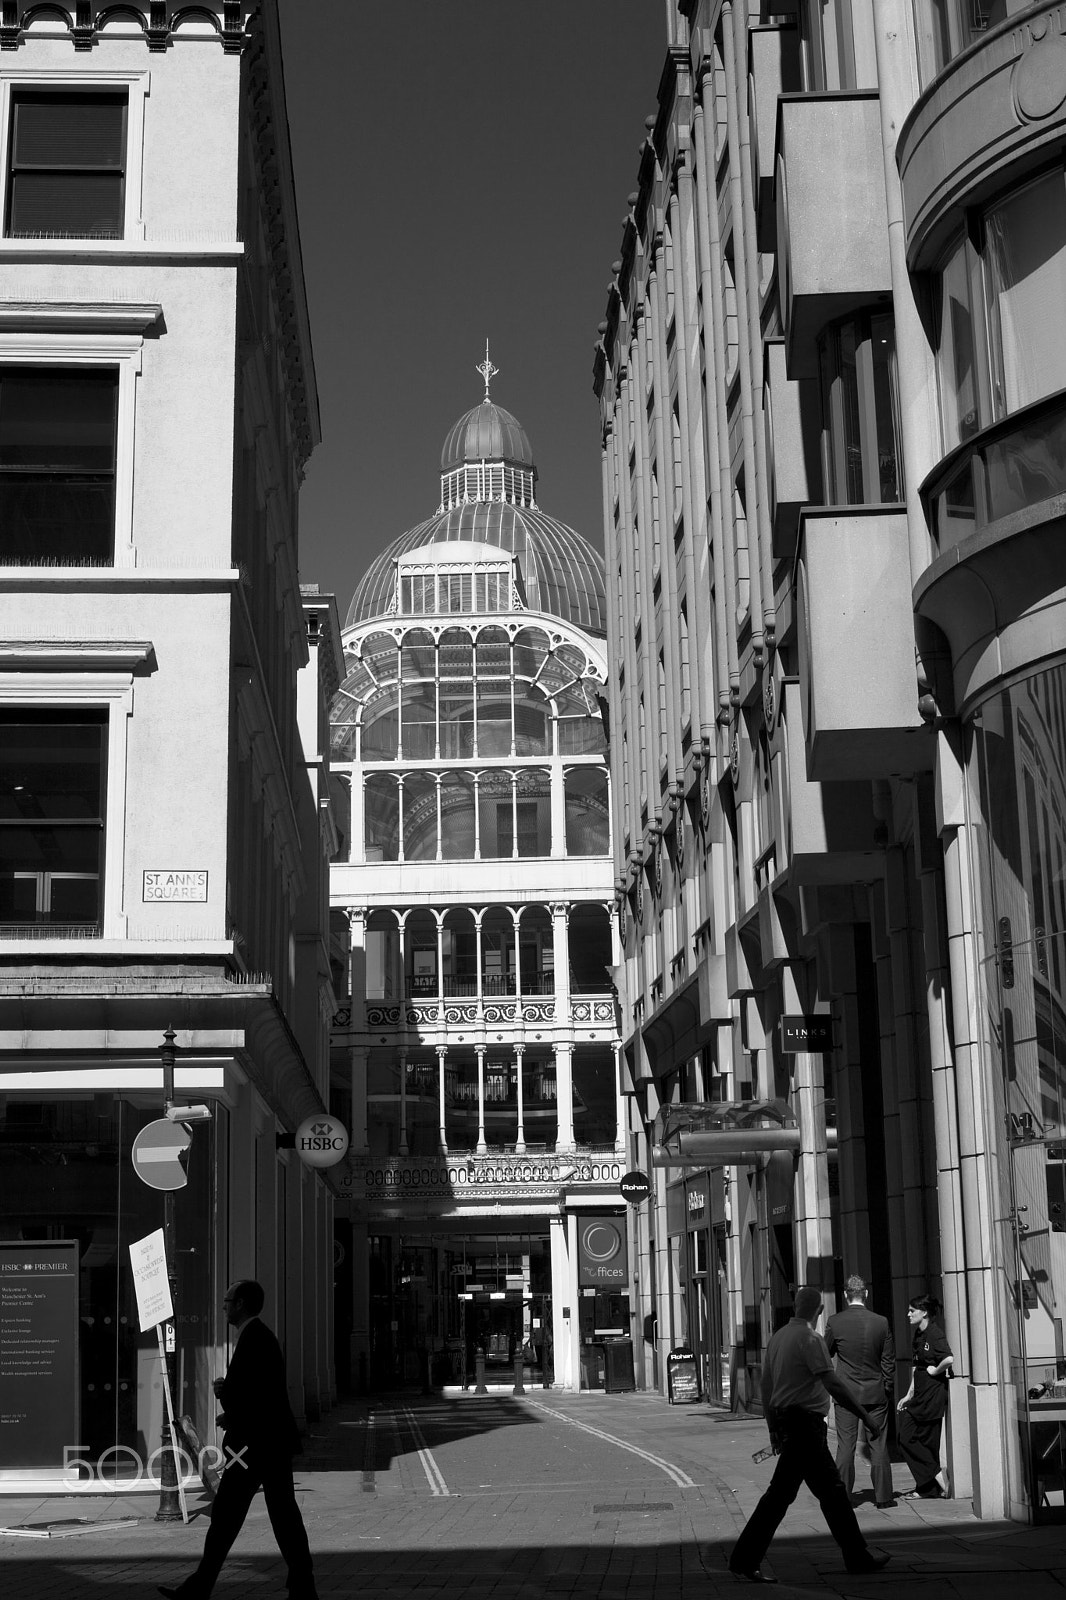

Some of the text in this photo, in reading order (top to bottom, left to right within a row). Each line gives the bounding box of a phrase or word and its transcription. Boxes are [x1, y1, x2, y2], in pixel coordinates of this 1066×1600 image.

[147, 887, 197, 899] SQUARE
[300, 1137, 344, 1151] HSBC
[1, 1262, 68, 1271] HSBC PREMIER
